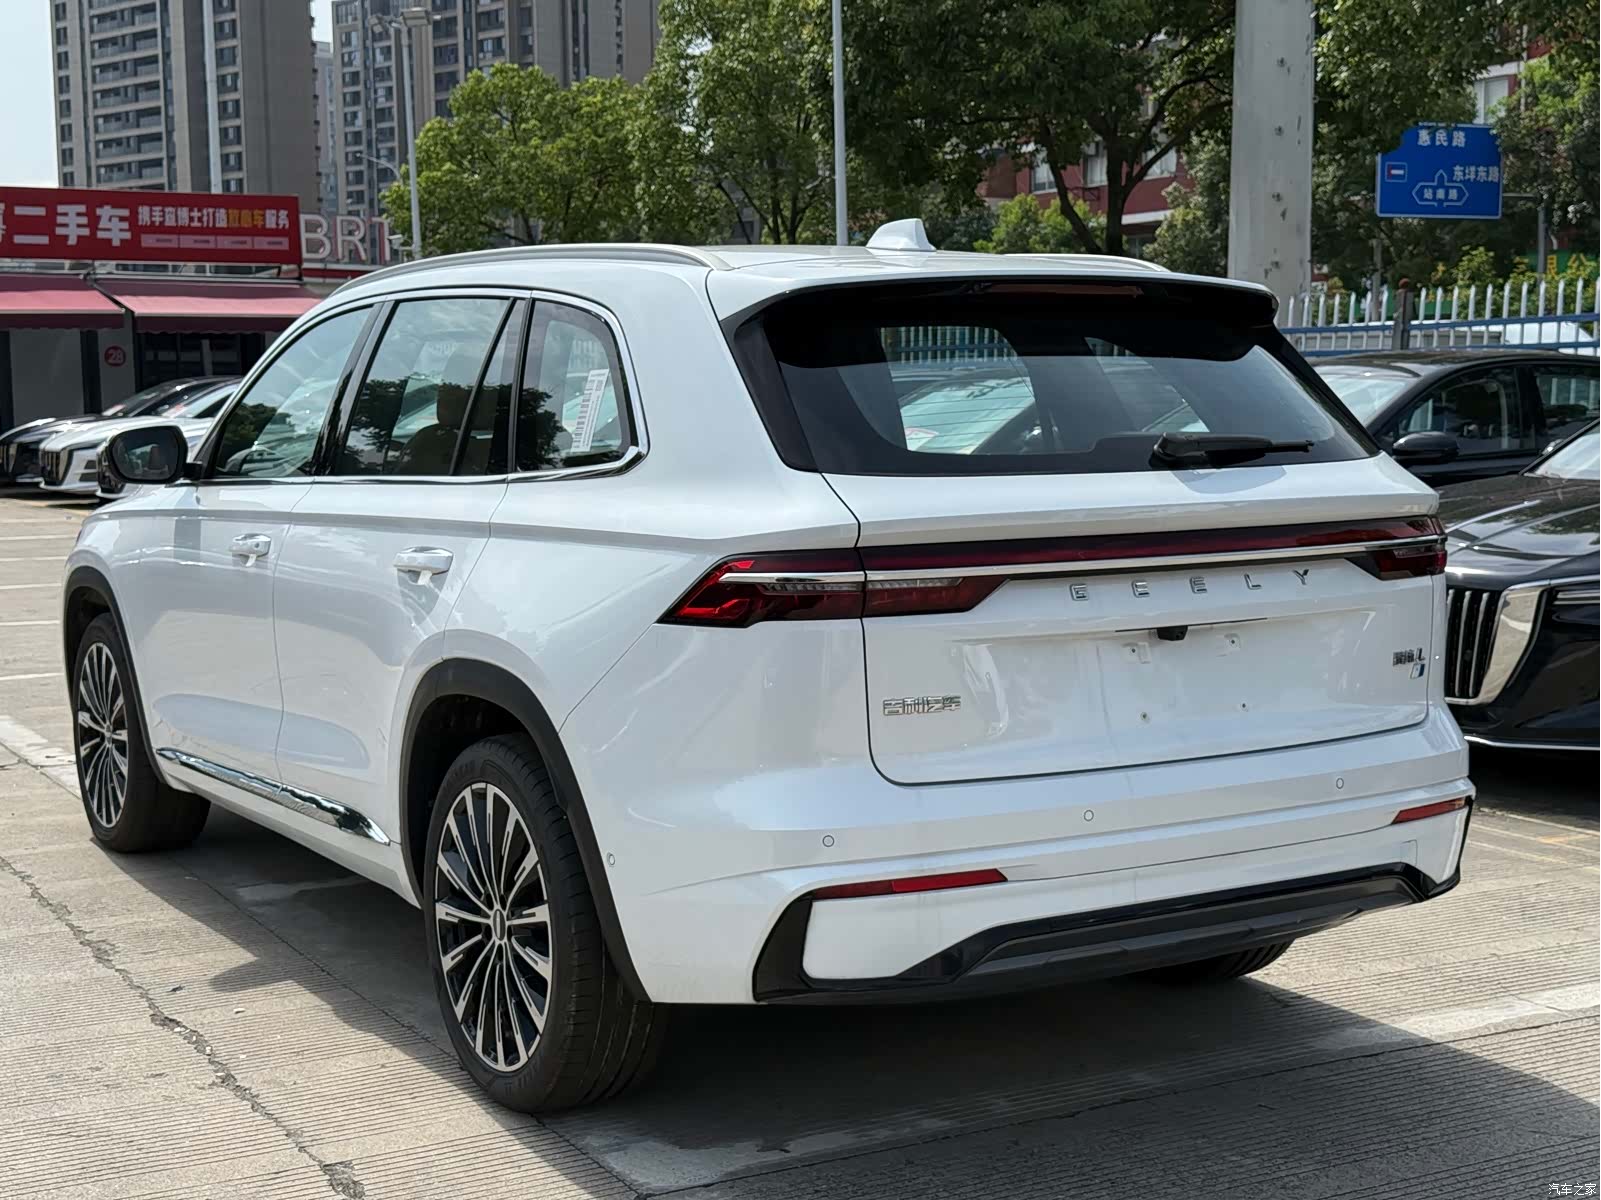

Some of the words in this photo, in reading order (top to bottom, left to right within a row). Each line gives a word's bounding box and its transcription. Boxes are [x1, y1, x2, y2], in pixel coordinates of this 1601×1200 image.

[1417, 128, 1466, 148] 惠民路
[0, 202, 132, 247] 二手车
[1069, 568, 1310, 601] GEELY
